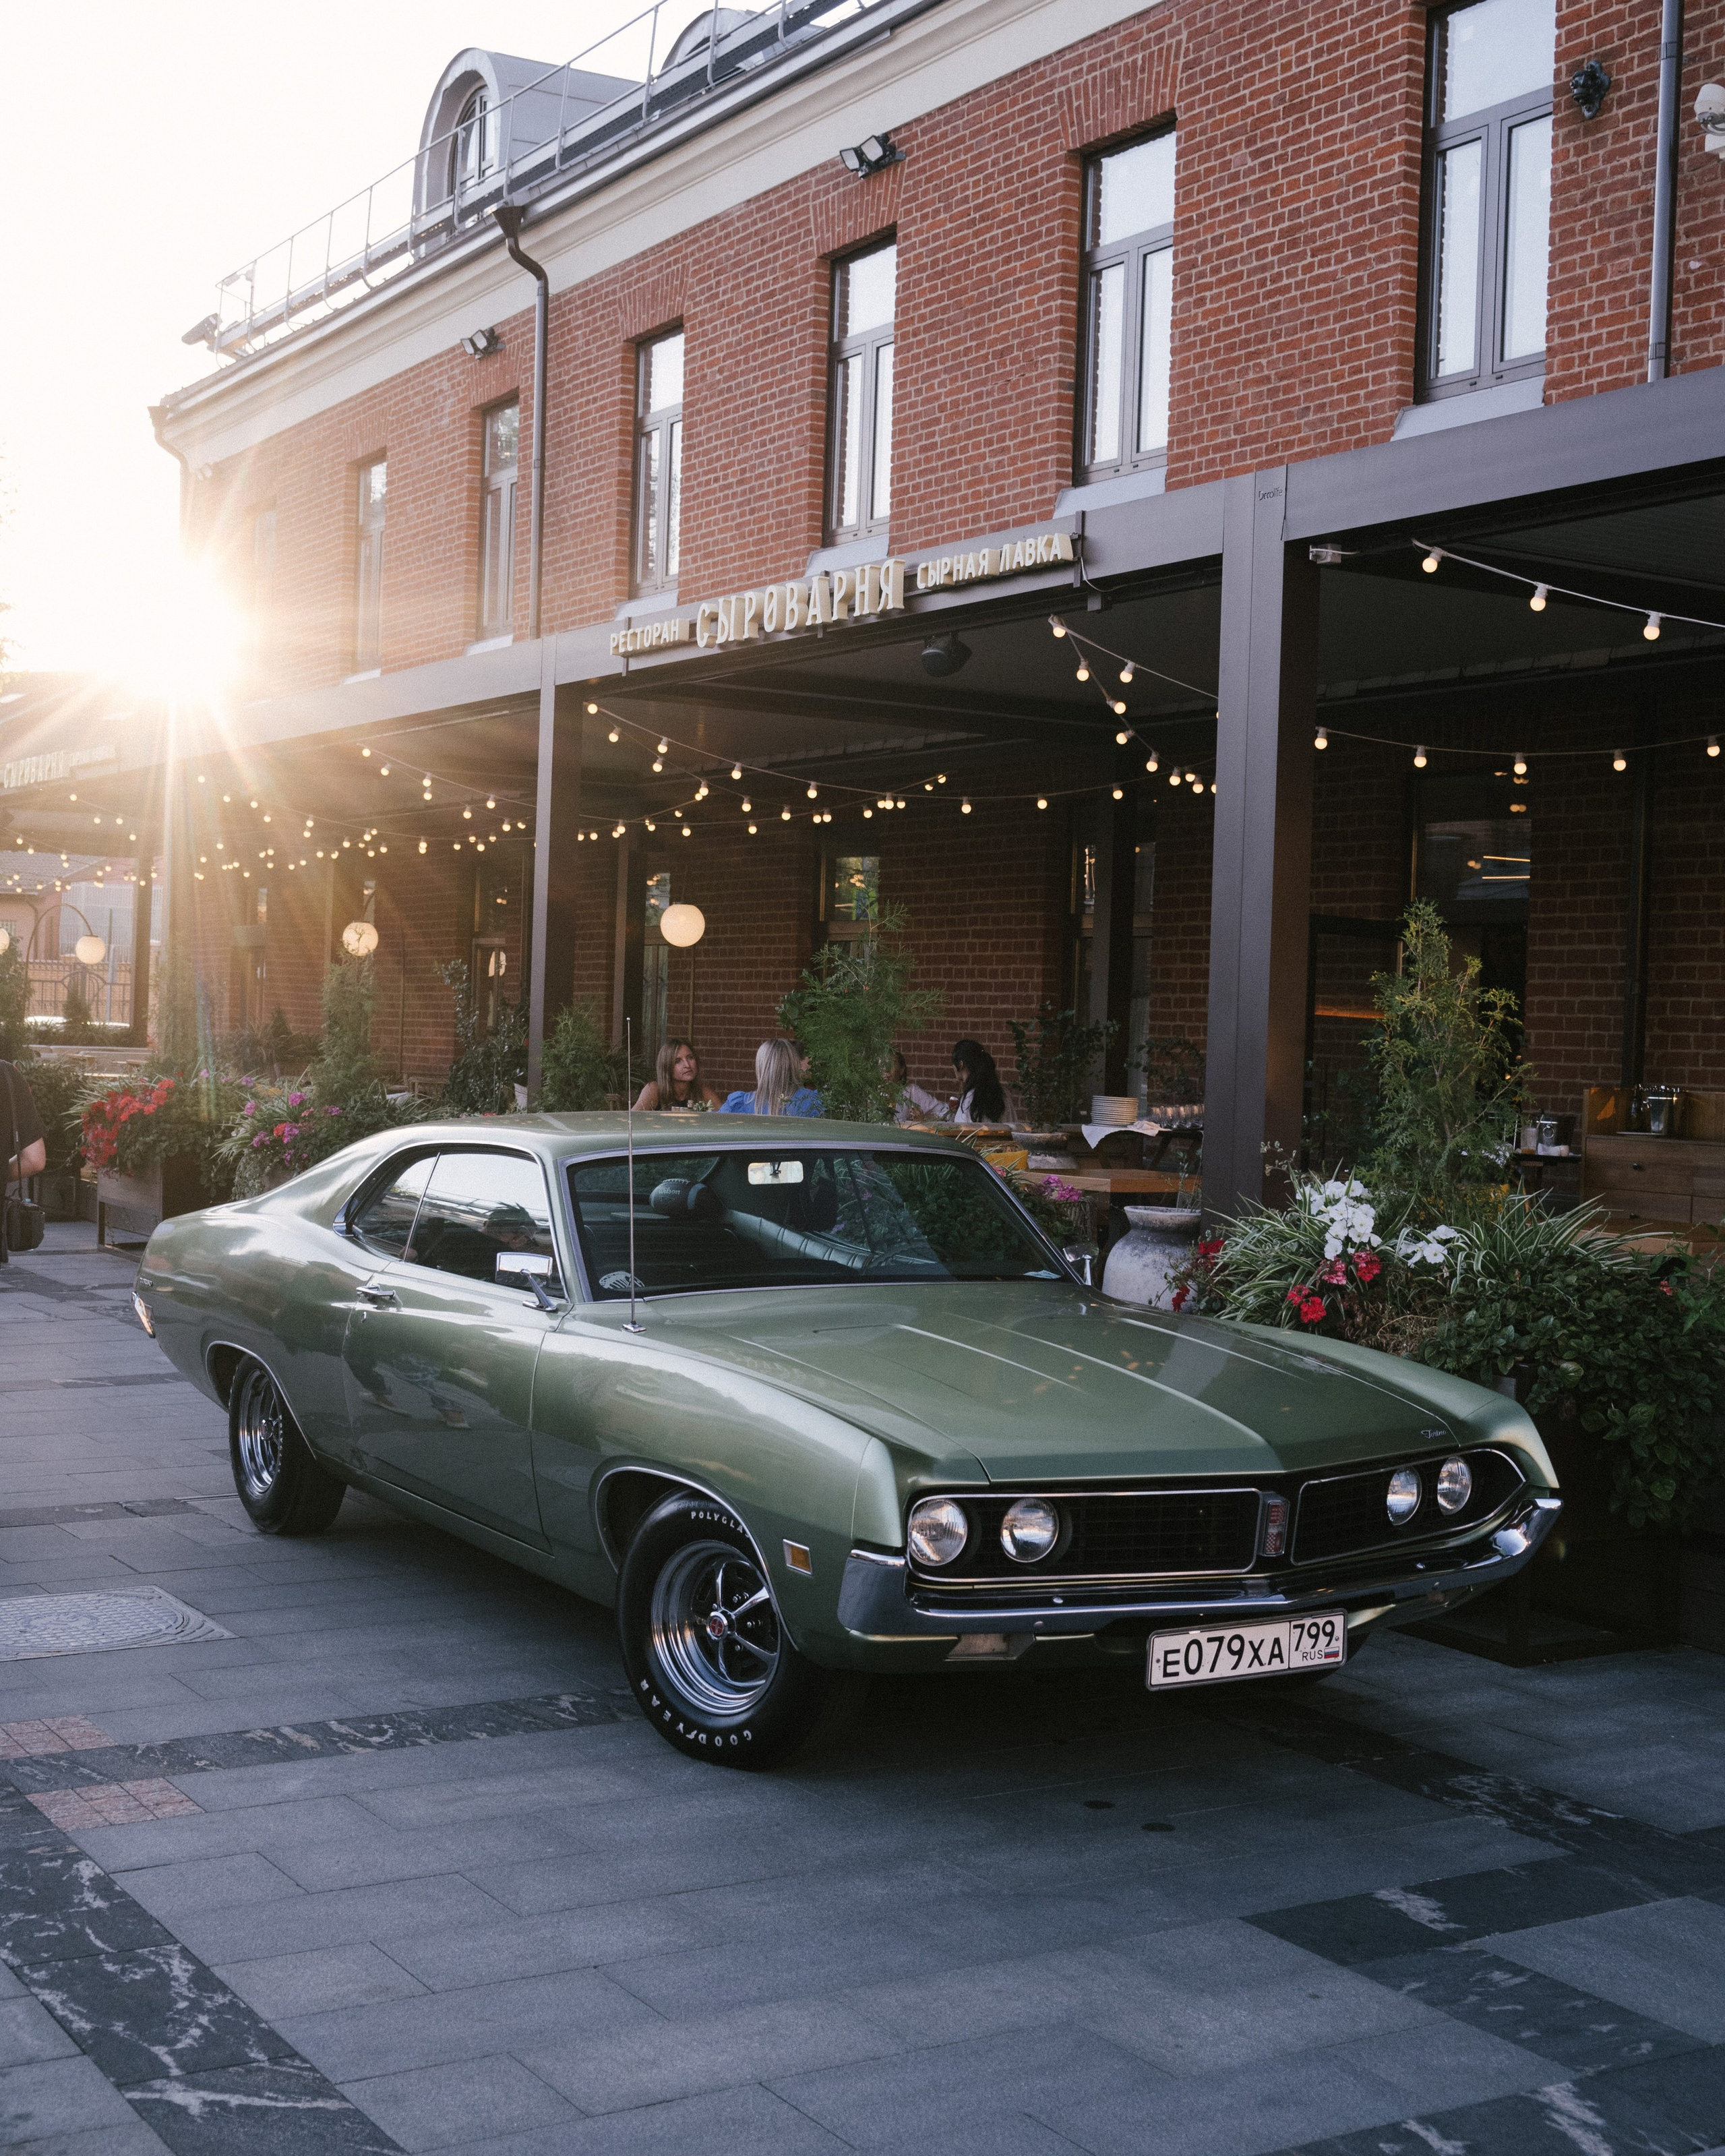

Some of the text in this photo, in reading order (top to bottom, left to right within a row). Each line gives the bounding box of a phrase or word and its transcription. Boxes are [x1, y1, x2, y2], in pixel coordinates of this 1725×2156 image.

[609, 533, 1064, 655] РЕСТОРАН СЫРОВАРНЯ СЫРНАЯ ЛАВКА
[658, 1187, 681, 1195] Wilson
[1420, 1429, 1447, 1439] Torino
[1292, 1619, 1335, 1652] 799
[1302, 1649, 1323, 1662] RUS
